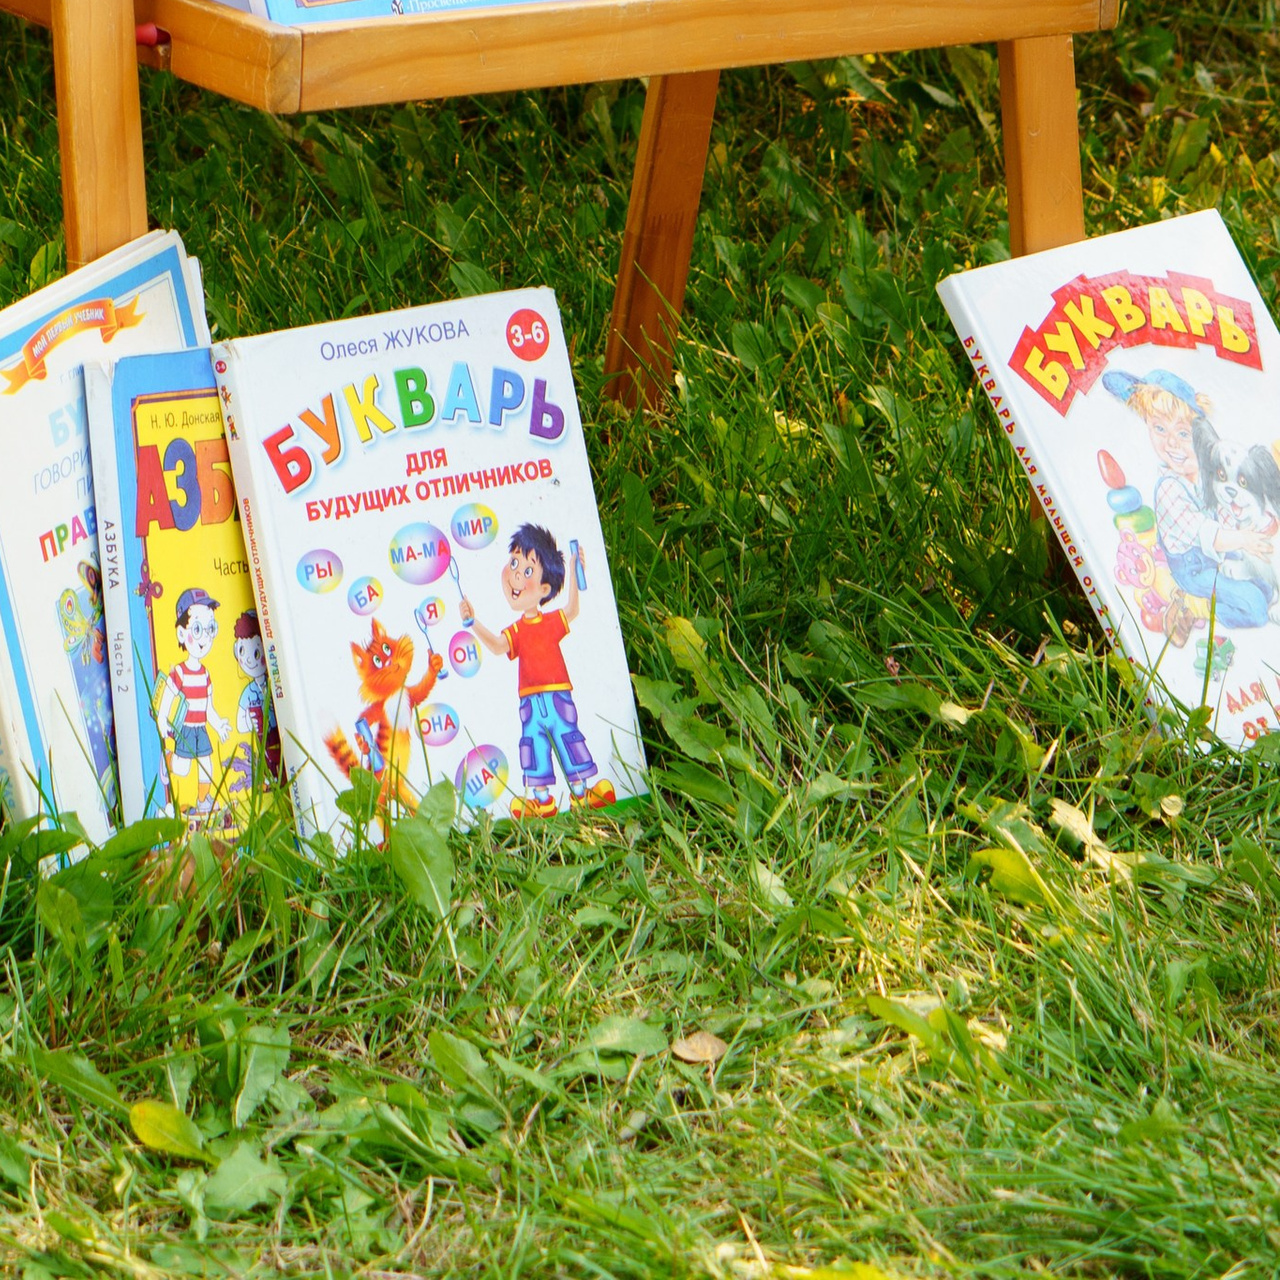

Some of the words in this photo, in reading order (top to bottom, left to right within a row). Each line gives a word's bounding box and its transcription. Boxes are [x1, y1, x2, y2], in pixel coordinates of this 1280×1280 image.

[32, 335, 48, 358] МОЙ
[46, 314, 74, 342] ПЕРВЫЙ
[74, 307, 105, 325] УЧЕБНИК
[320, 339, 379, 361] Олеся
[383, 319, 470, 351] ЖУКОВА
[509, 321, 546, 348] 3-6
[1022, 284, 1251, 402] БУКВАРЬ
[962, 335, 1017, 436] БУКВАРЬ
[48, 396, 88, 447] БУ
[150, 414, 162, 429] Н.
[164, 411, 178, 428] Ю.
[181, 410, 221, 428] Донская
[262, 361, 565, 494] БУКВАРЬ
[33, 444, 91, 495] ГОВОРИ
[405, 447, 449, 477] ДЛЯ
[135, 433, 240, 538] АЗБ
[305, 484, 412, 522] БУДУЩИХ
[415, 458, 553, 501] ОТЛИЧНИКОВ
[39, 505, 98, 563] ПРАВ
[242, 497, 260, 565] ОТЛИЧНИКОВ
[456, 516, 493, 538] МИР
[103, 519, 120, 590] АЗБУКА
[213, 557, 250, 577] Часть
[304, 560, 333, 581] РЫ
[390, 539, 450, 564] МА-МА
[254, 567, 269, 617] БУДУЩИХ
[354, 584, 379, 609] БА
[426, 602, 439, 620] Я
[261, 618, 274, 639] ДЛЯ
[113, 631, 125, 678] Часть
[268, 644, 284, 699] БУКВАРЬ
[453, 644, 479, 664] ОН
[117, 684, 129, 694] 2
[420, 713, 456, 736] ОНА
[466, 758, 500, 796] ШАР
